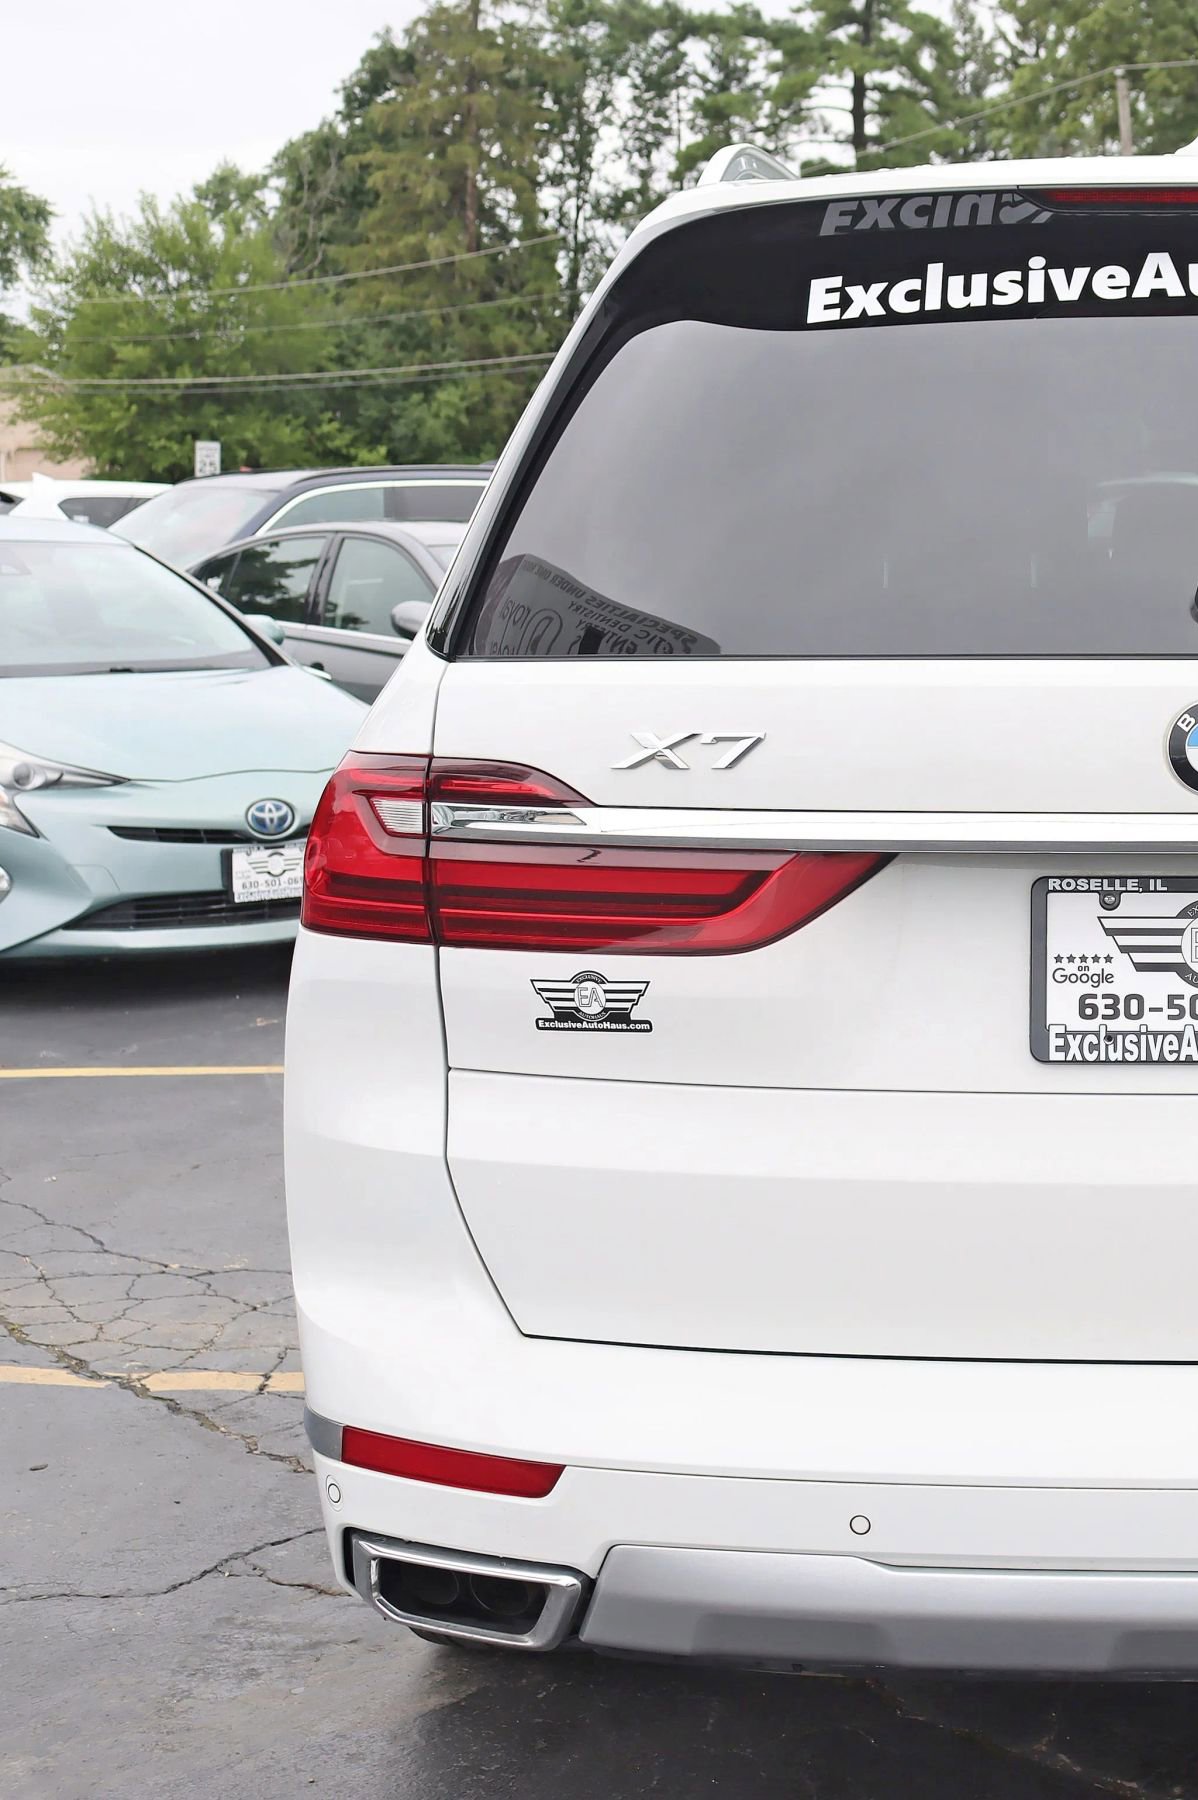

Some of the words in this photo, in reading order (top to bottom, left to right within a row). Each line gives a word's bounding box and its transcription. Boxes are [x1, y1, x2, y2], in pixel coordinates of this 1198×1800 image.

[610, 731, 766, 770] X7
[241, 876, 304, 891] 630-501-06
[1048, 878, 1143, 893] ROSELLE,
[1149, 879, 1168, 892] IL
[1052, 967, 1114, 988] Google
[577, 986, 604, 1008] EA
[538, 1019, 650, 1031] ExclusiveAutoHaus.com
